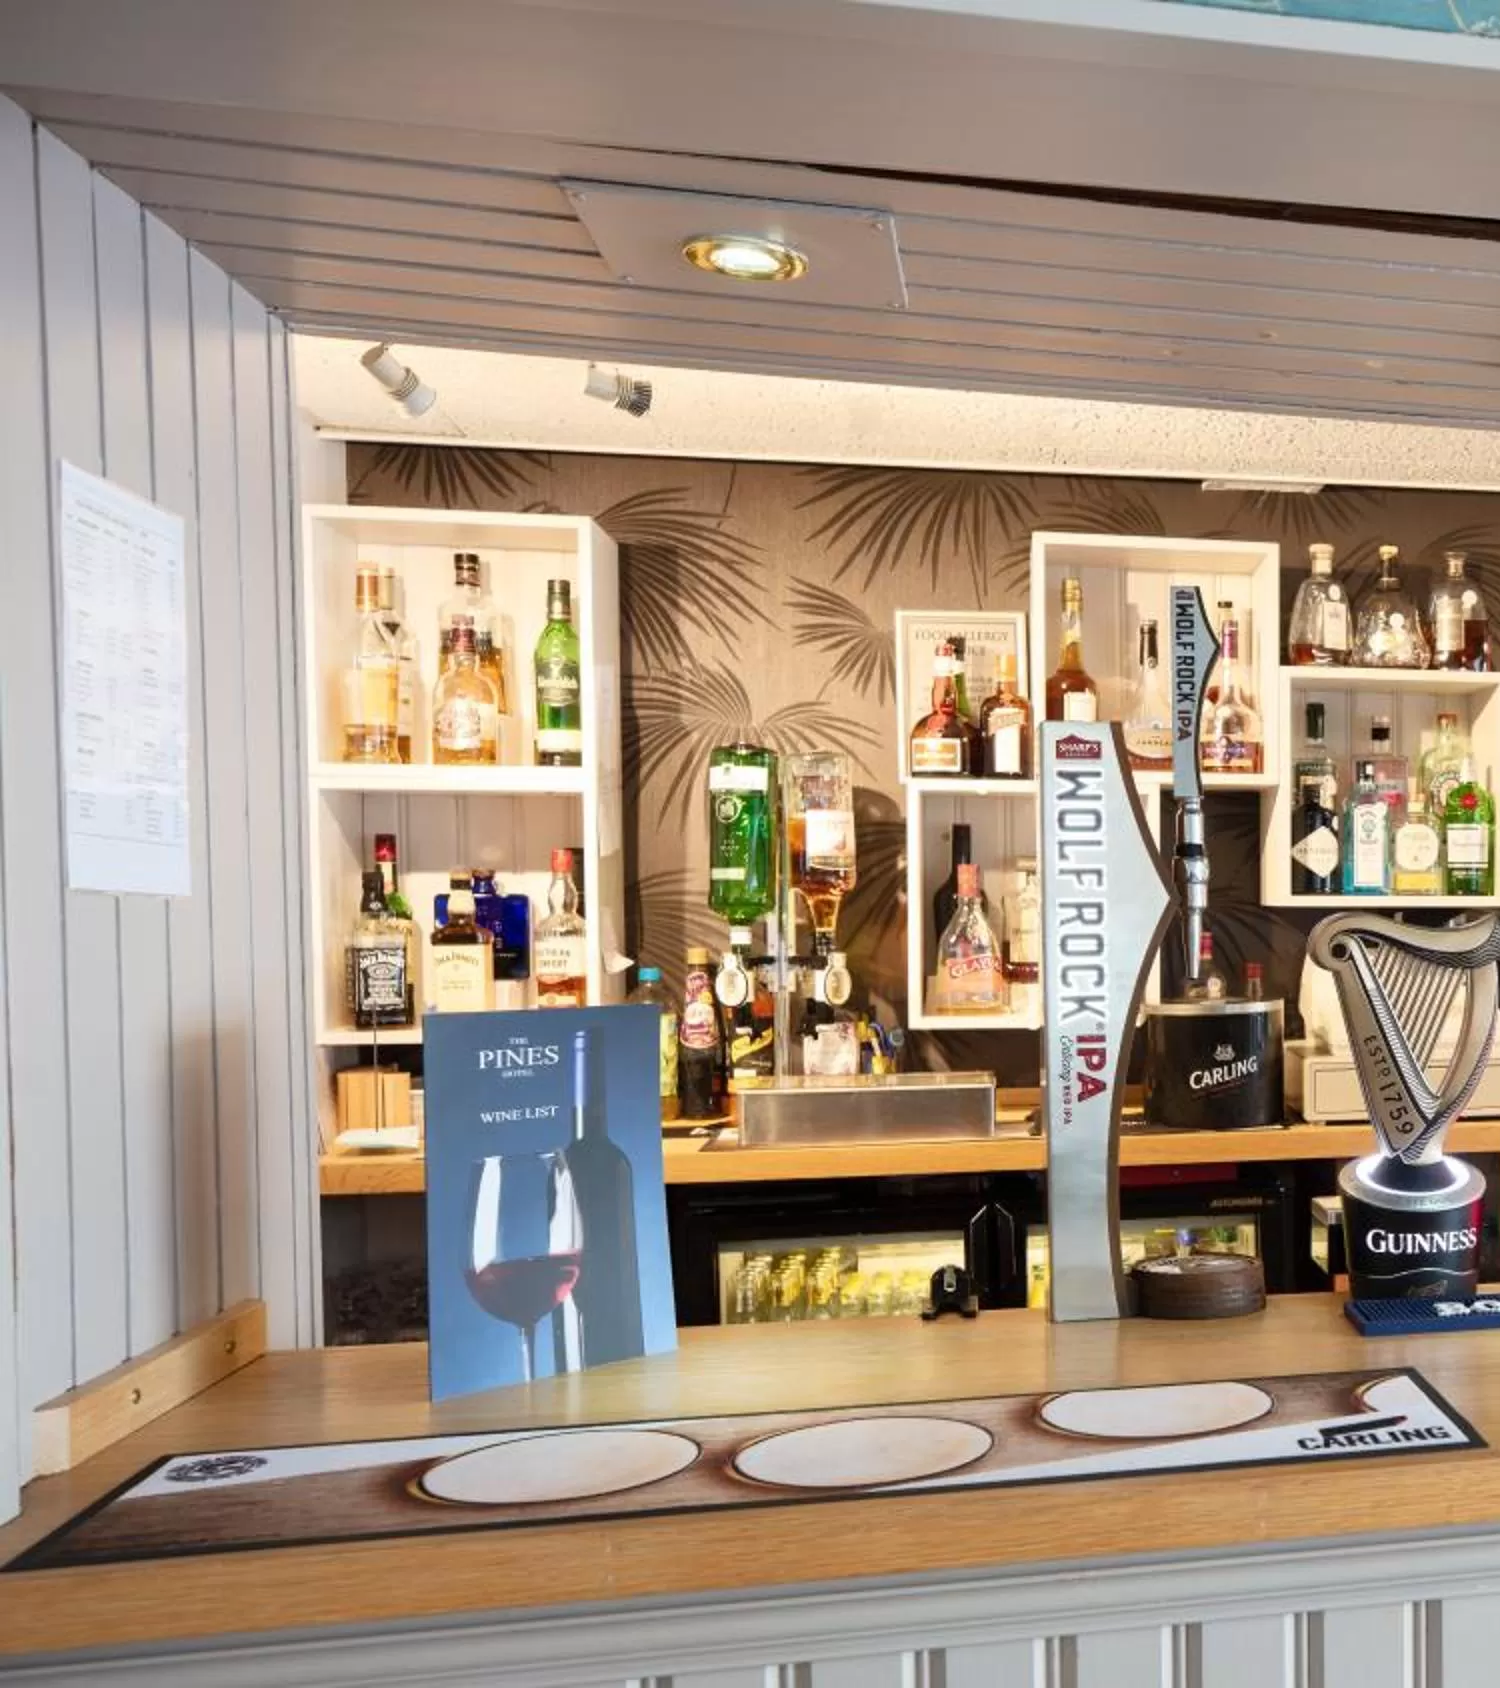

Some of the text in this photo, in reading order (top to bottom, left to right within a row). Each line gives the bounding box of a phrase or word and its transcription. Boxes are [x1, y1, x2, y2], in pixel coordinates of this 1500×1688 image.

[1176, 602, 1195, 651] WOLF
[1176, 656, 1196, 704] ROCK
[1177, 710, 1193, 742] IPA
[1059, 743, 1099, 753] SHARP'S
[480, 1045, 560, 1069] PINES
[1076, 1034, 1107, 1103] IPA
[1189, 1055, 1260, 1090] CARLING
[480, 1104, 560, 1124] WINE LIST
[1379, 1081, 1414, 1135] 1759
[1366, 1227, 1478, 1255] GUINNESS
[1297, 1425, 1451, 1451] CARLING
